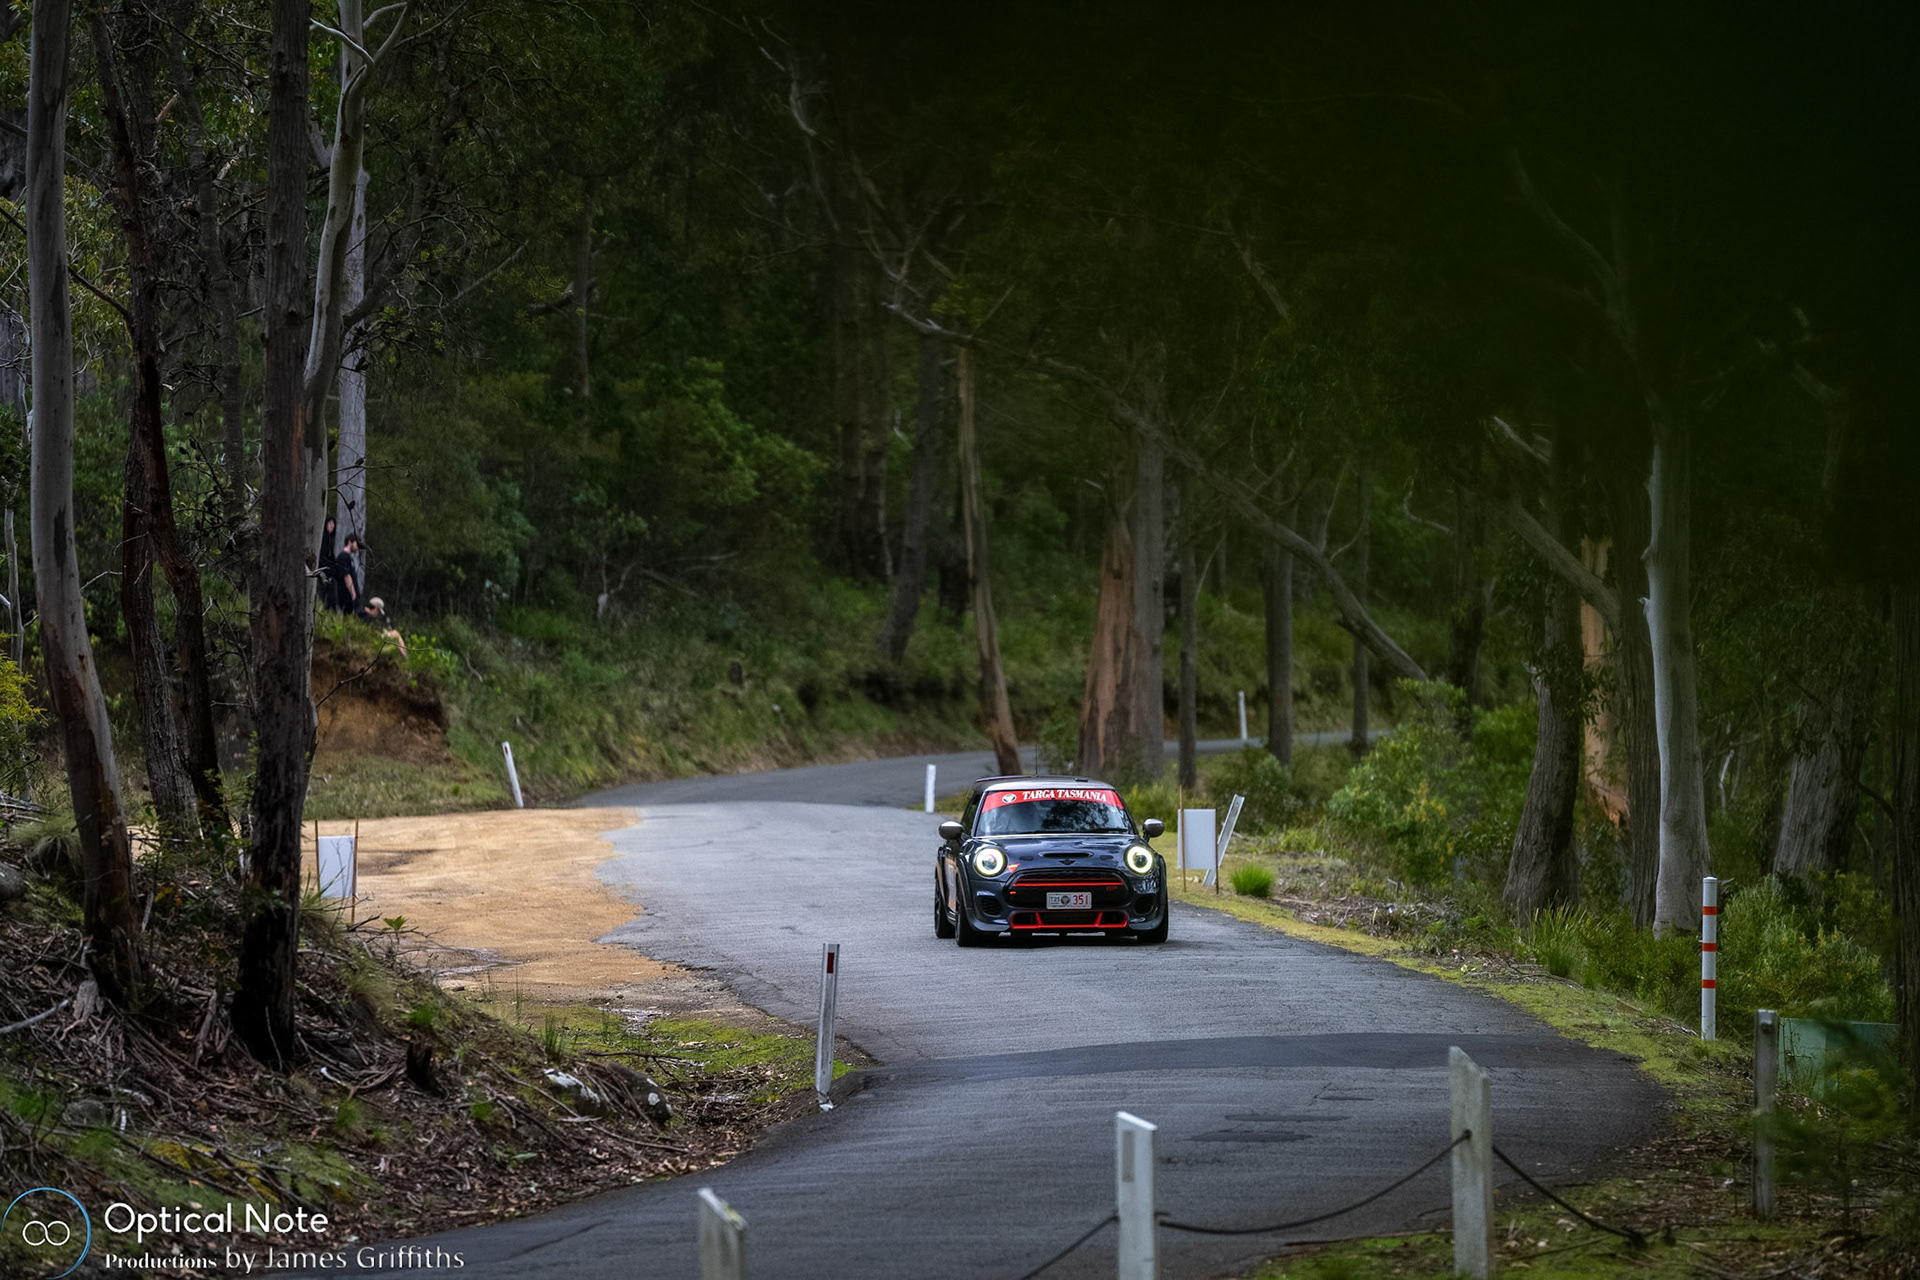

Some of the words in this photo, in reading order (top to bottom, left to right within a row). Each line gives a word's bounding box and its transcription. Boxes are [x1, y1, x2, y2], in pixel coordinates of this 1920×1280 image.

[1022, 790, 1055, 801] TARGA
[1056, 789, 1107, 802] TASMANIA
[1073, 894, 1088, 905] 351
